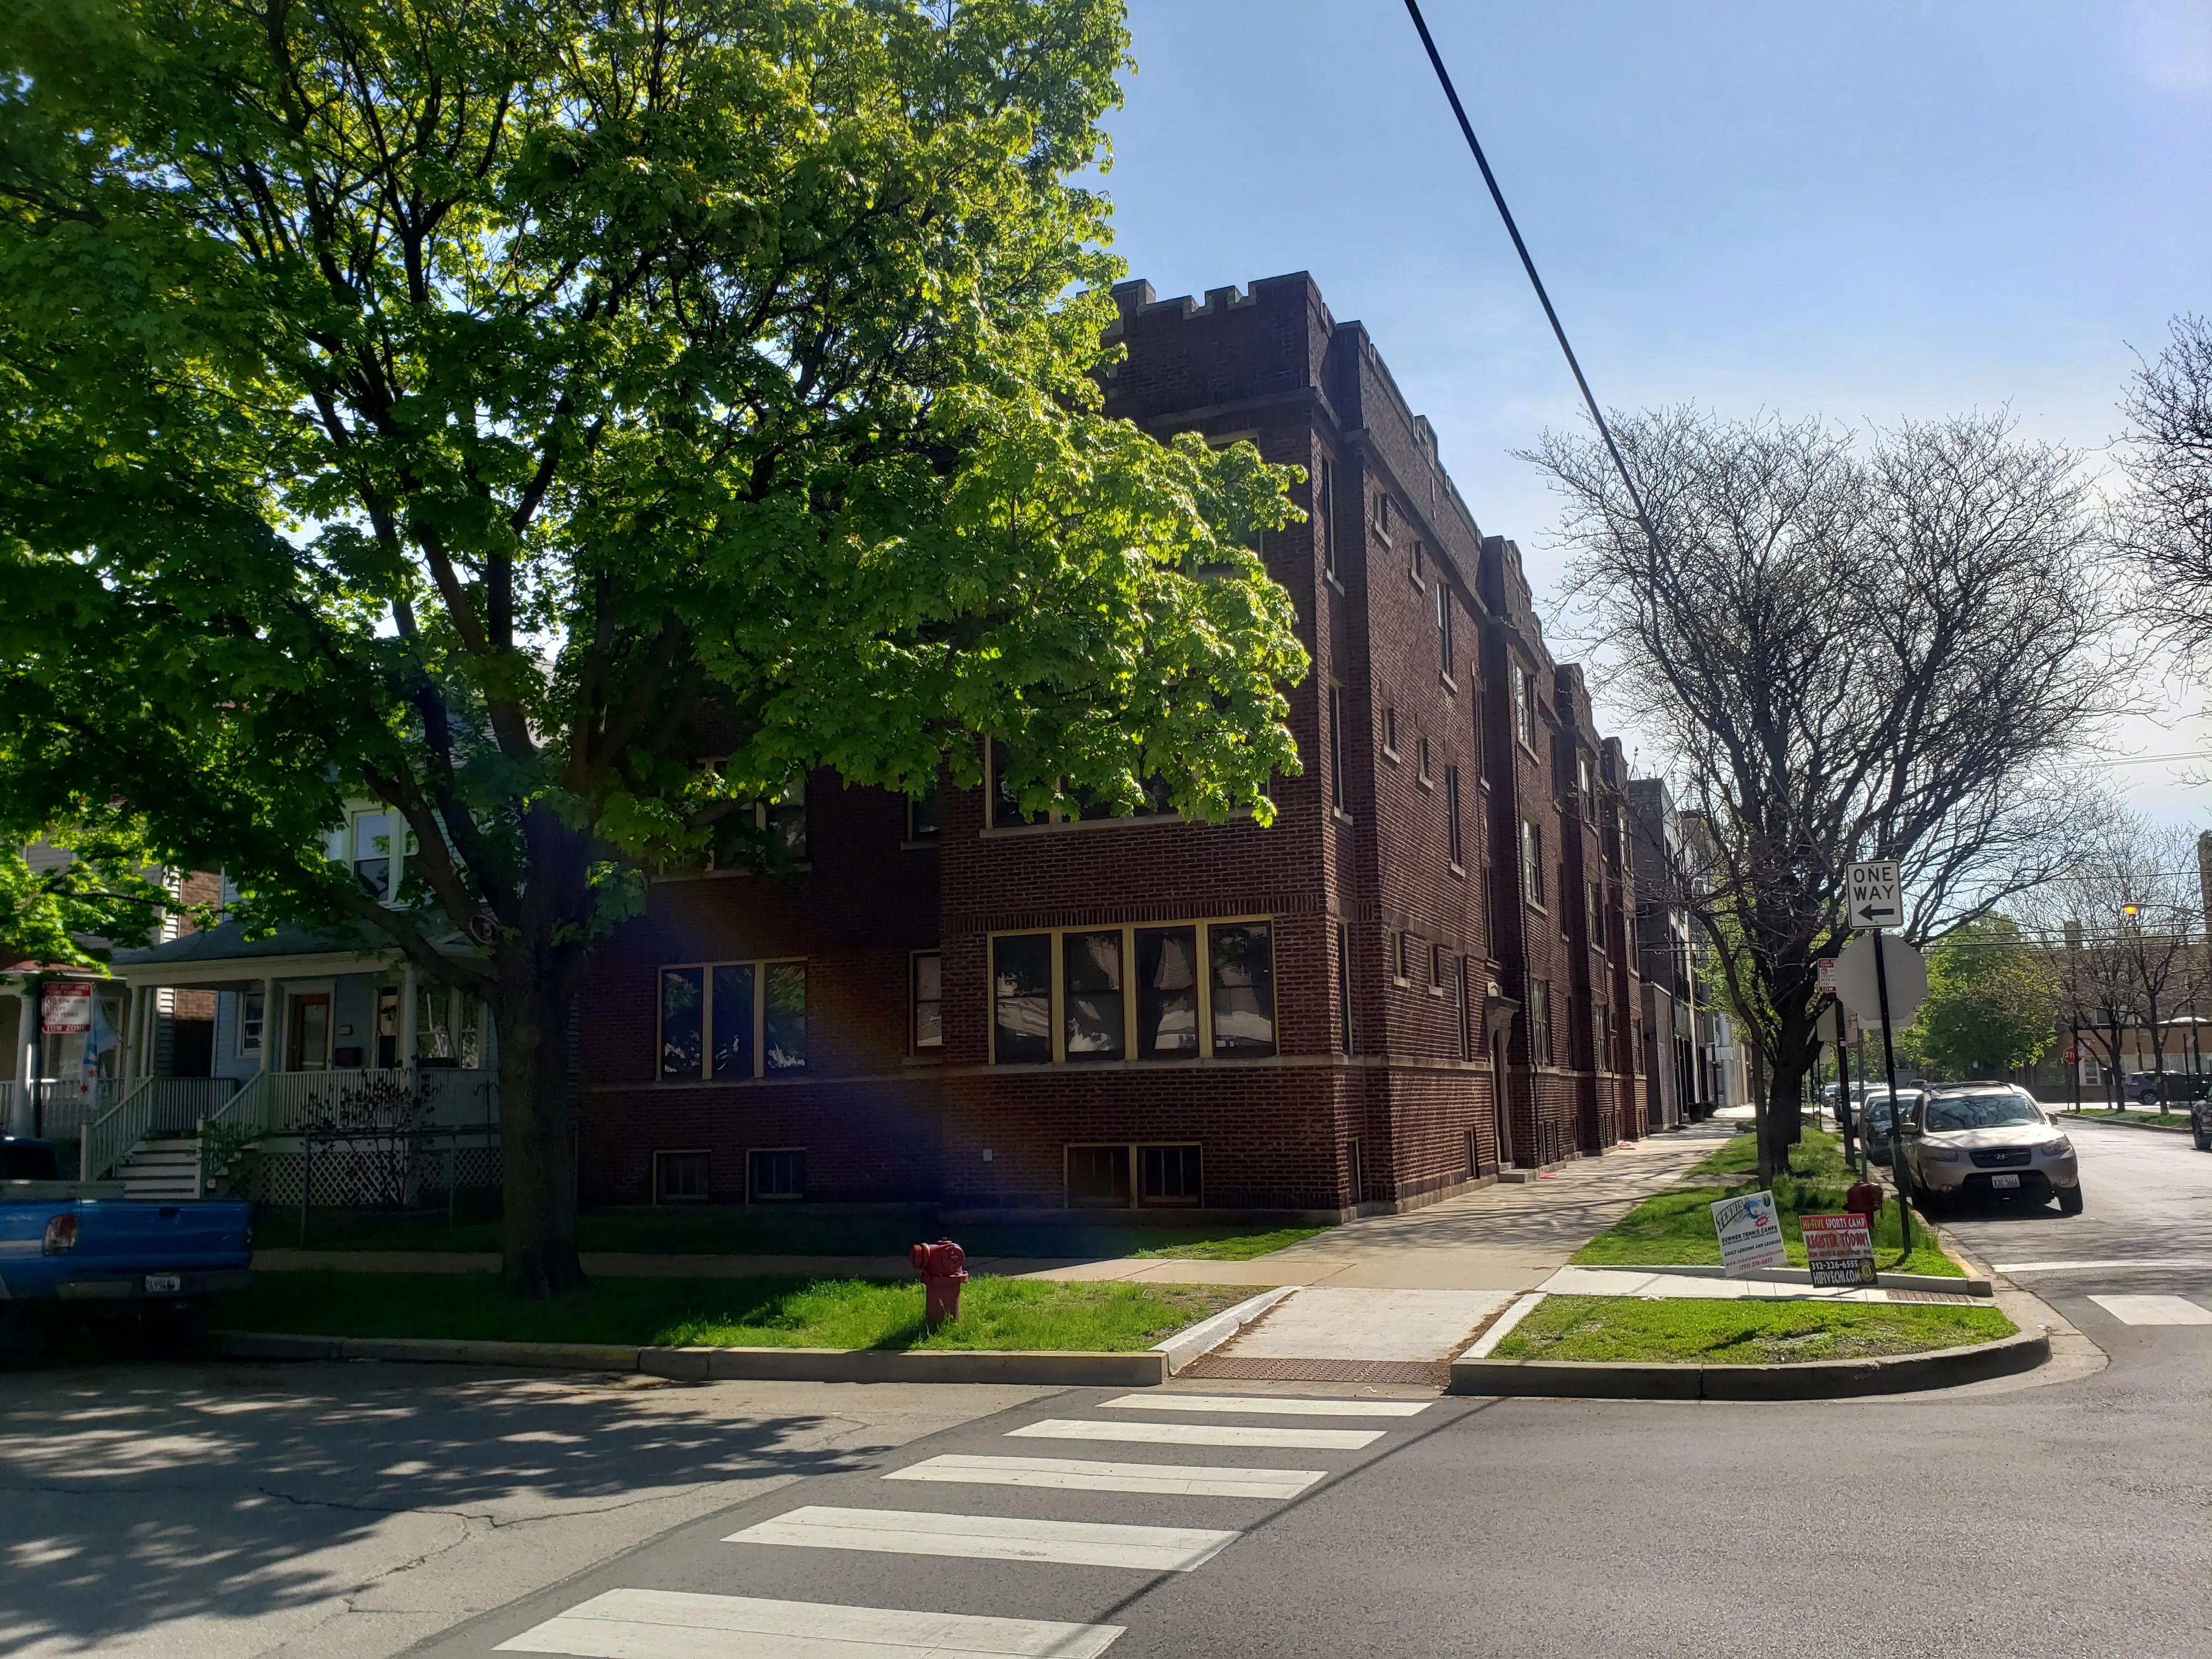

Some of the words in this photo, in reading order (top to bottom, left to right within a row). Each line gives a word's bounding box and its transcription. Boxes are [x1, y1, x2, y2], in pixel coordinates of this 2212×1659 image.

[1854, 867, 1893, 883] ONE
[1853, 885, 1894, 901] WAY
[1716, 1199, 1744, 1233] TENNIS
[1802, 1219, 1824, 1229] HI-FIVE
[1825, 1218, 1847, 1228] SPORTS
[1848, 1217, 1865, 1227] CAMP
[1722, 1234, 1741, 1243] SUMMER
[1742, 1229, 1760, 1238] TENNIS
[1761, 1225, 1778, 1233] CAMPS
[1737, 1245, 1754, 1254] LESSONS
[1764, 1238, 1782, 1246] LEAGUES
[1811, 1260, 1858, 1270] 312-226-6555
[1813, 1269, 1861, 1284] HIFIVECHI.COM
